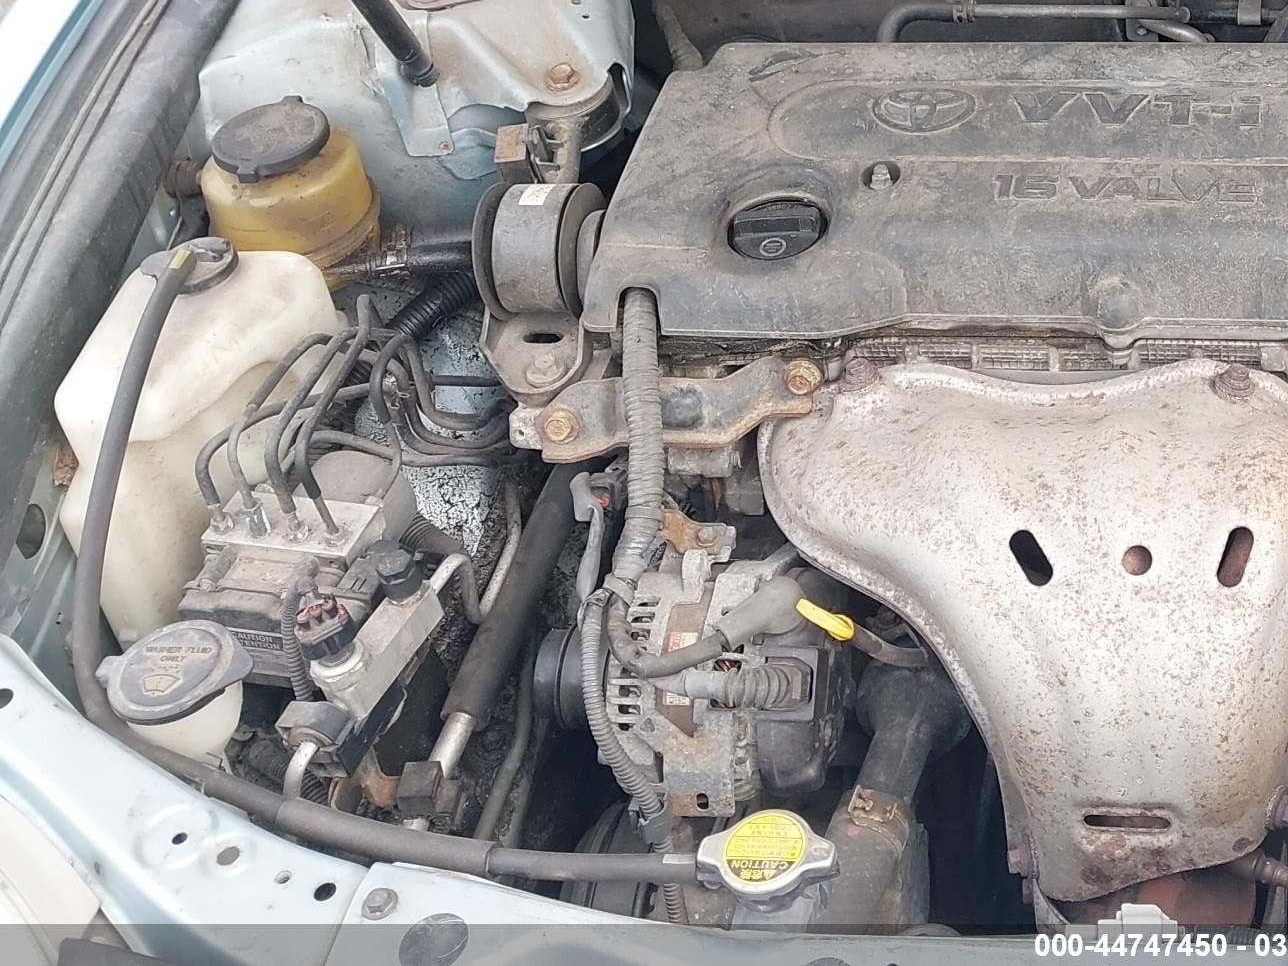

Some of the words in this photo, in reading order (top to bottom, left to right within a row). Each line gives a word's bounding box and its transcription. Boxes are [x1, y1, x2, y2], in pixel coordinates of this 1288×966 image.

[994, 174, 1057, 200] 16
[1066, 175, 1258, 203] VALVE
[231, 632, 273, 642] AUTION
[731, 860, 788, 870] CAUTION
